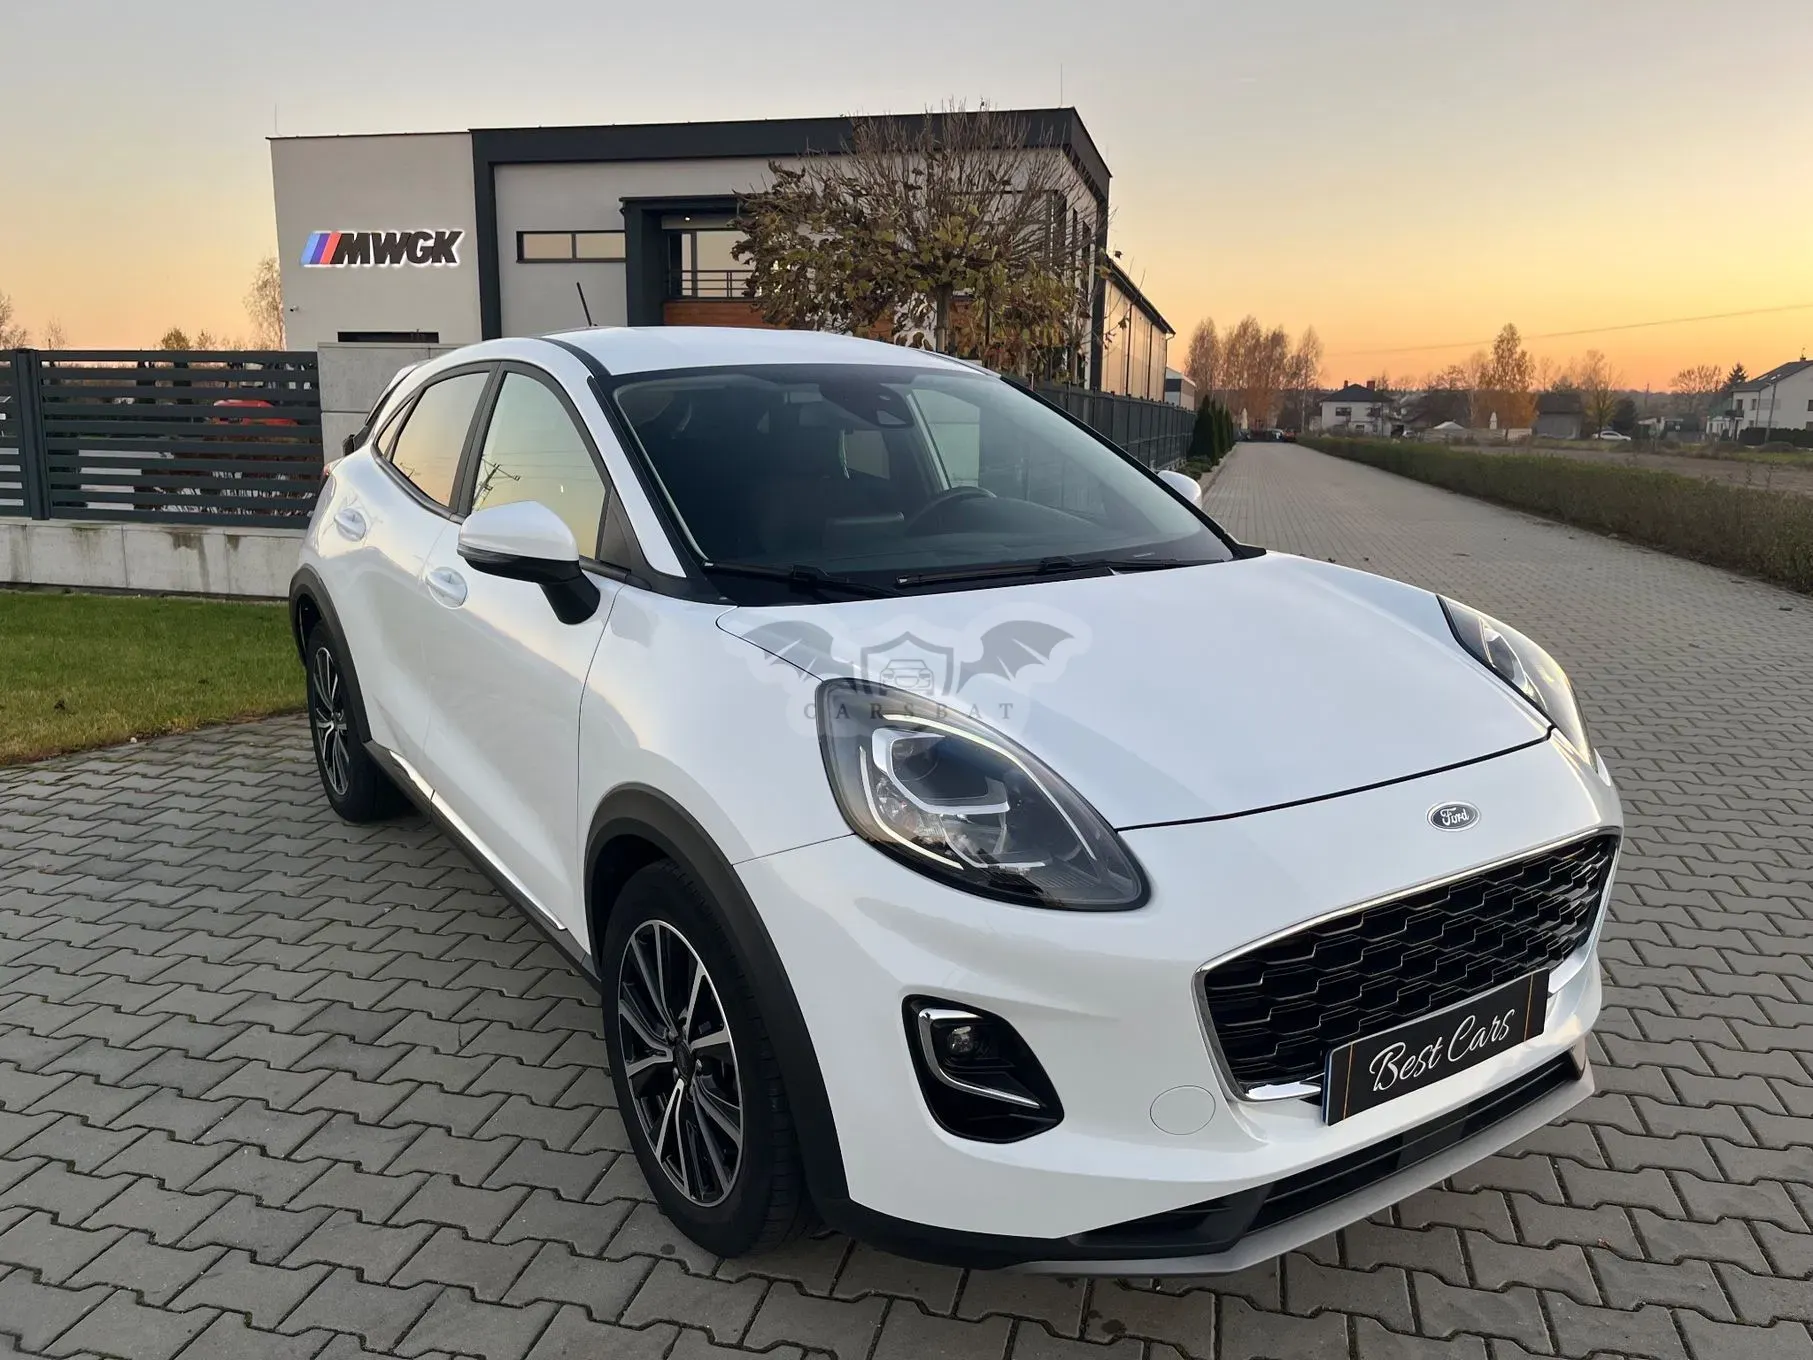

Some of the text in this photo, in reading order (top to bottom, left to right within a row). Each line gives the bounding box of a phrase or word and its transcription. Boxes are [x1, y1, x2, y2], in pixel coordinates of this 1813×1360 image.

[330, 231, 462, 264] MWGK
[1440, 807, 1470, 826] Ford
[1368, 1008, 1516, 1092] Best Cars
